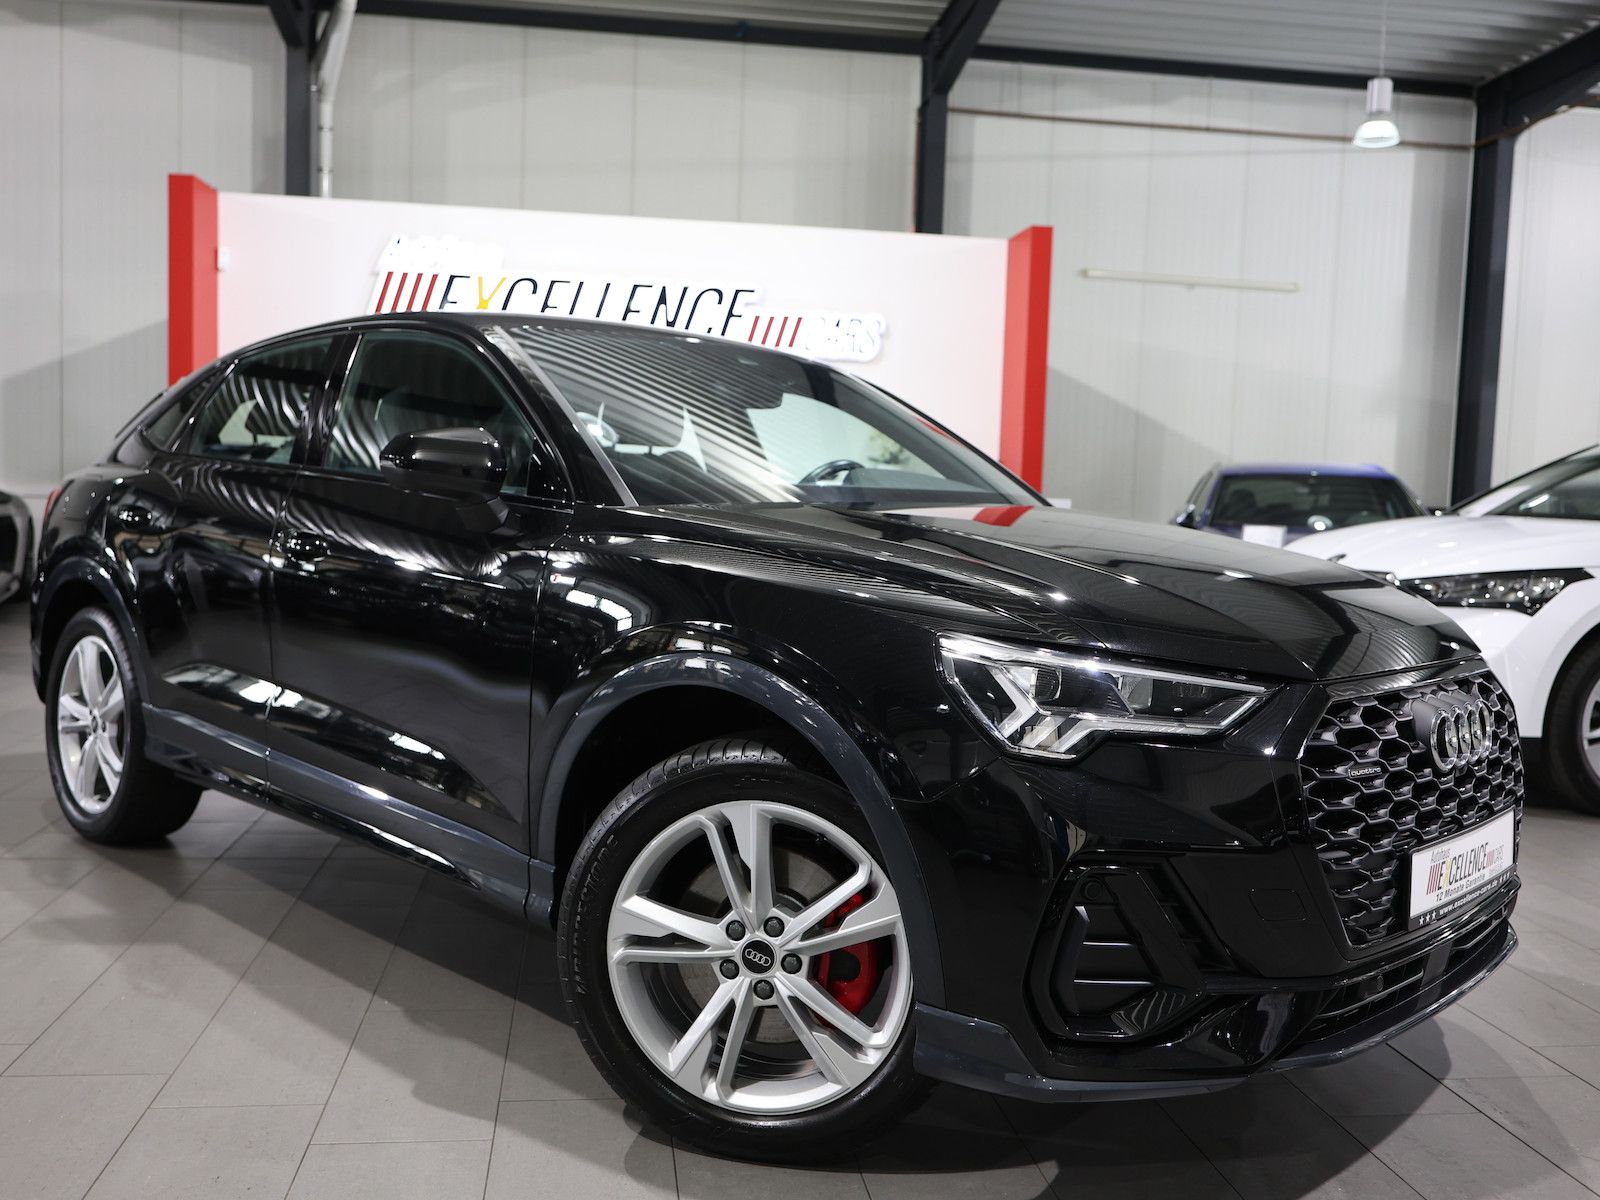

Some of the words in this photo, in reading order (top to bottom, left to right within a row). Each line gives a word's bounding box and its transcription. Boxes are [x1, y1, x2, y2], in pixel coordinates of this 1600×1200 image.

[1350, 767, 1382, 776] quattro
[1437, 842, 1489, 891] EXCELLENCE
[1436, 891, 1444, 902] 12
